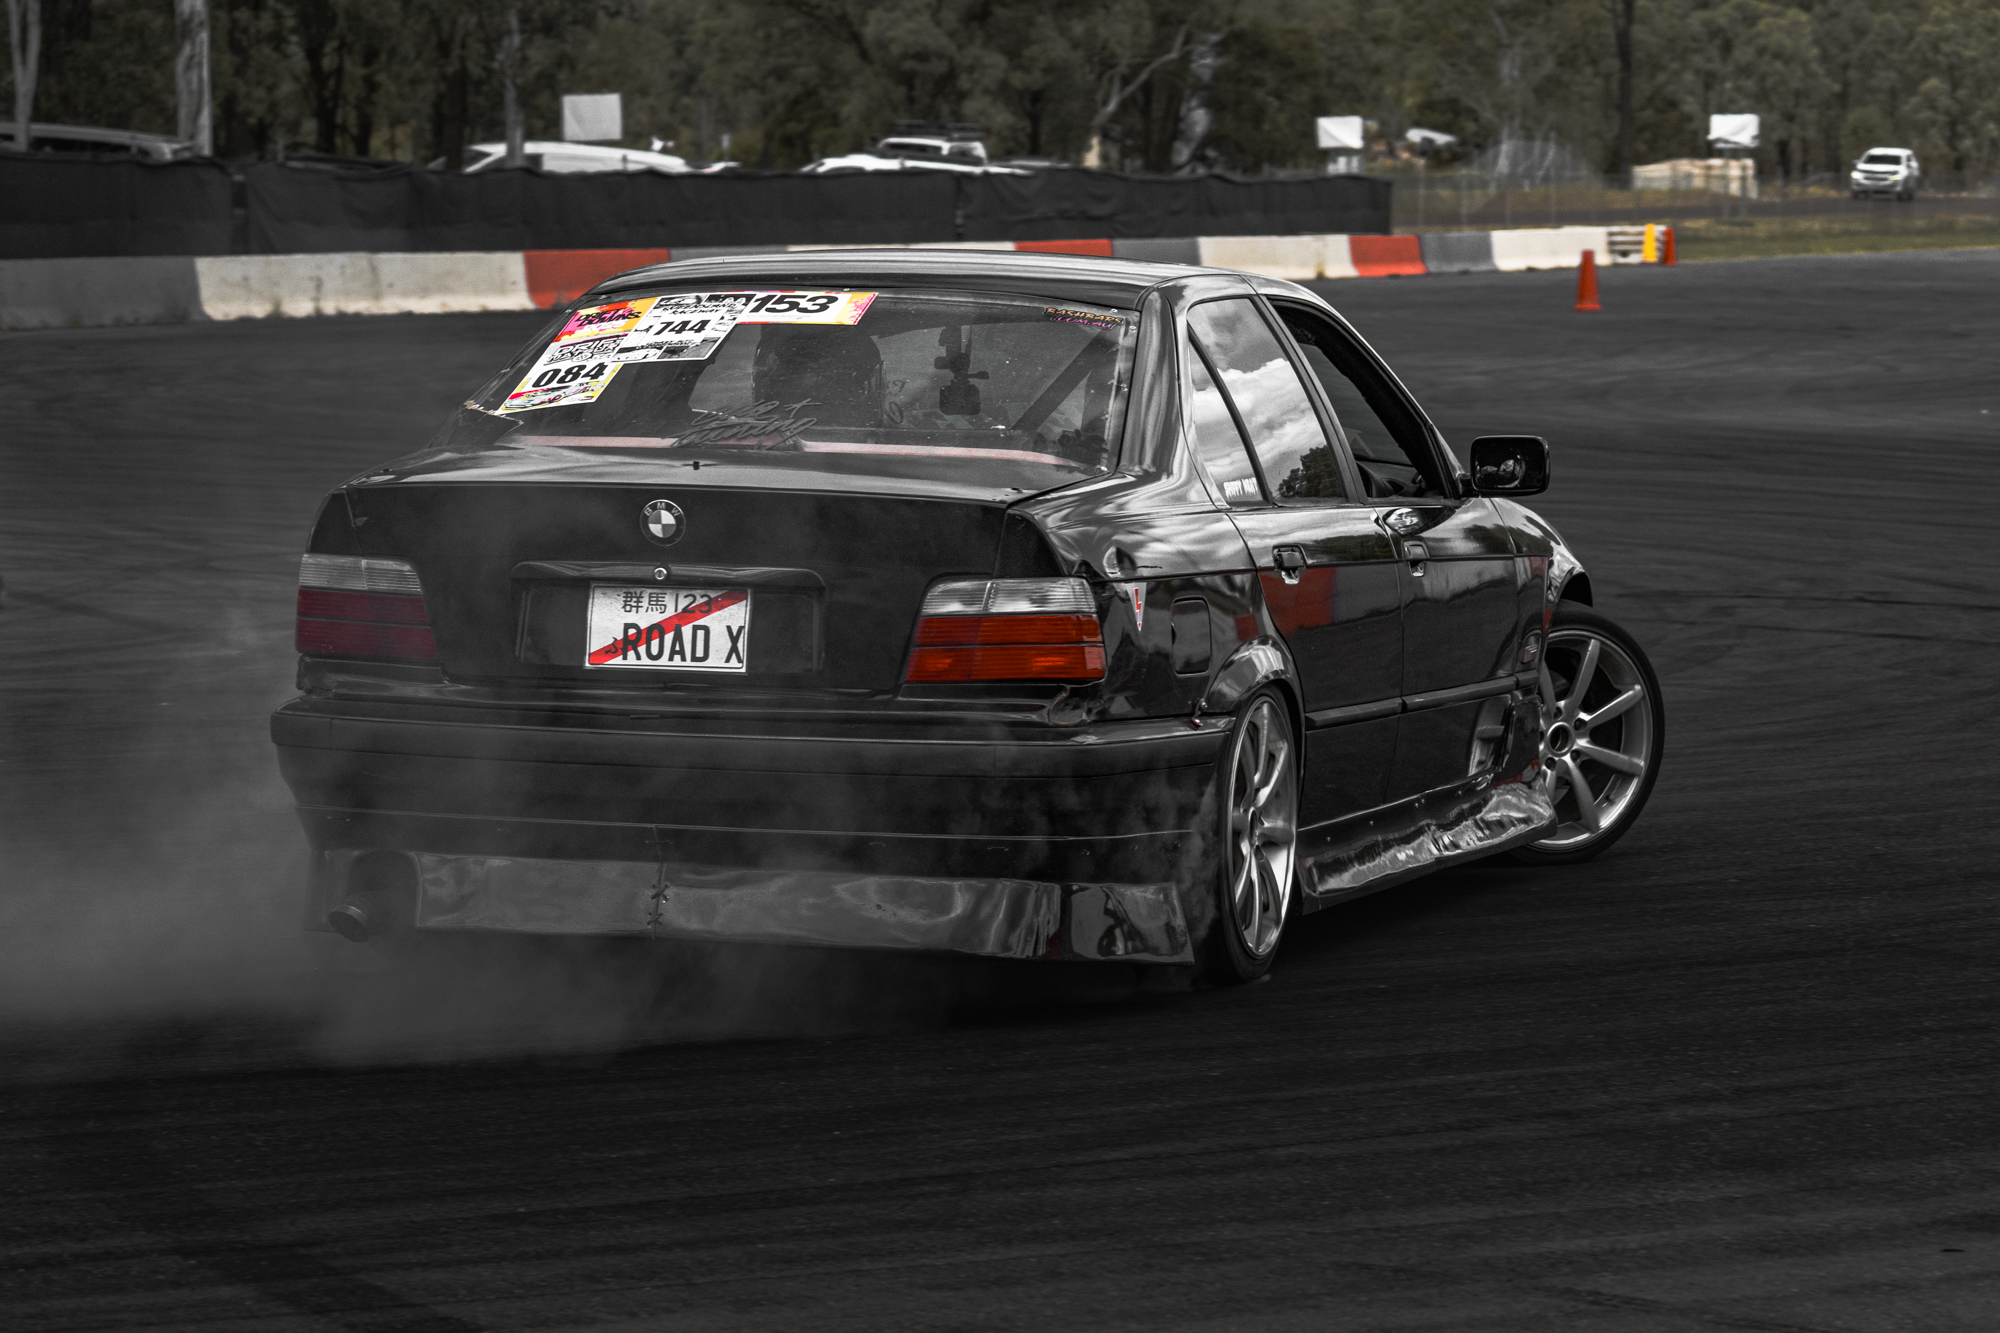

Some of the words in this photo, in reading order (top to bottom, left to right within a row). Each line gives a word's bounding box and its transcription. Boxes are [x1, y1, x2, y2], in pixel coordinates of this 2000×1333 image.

[749, 295, 838, 313] 153
[653, 319, 712, 336] 744
[532, 362, 609, 388] 084
[644, 502, 681, 517] BMW
[621, 591, 667, 614] 群馬
[674, 593, 713, 614] 123
[622, 622, 711, 663] ROAD
[724, 625, 745, 664] X
